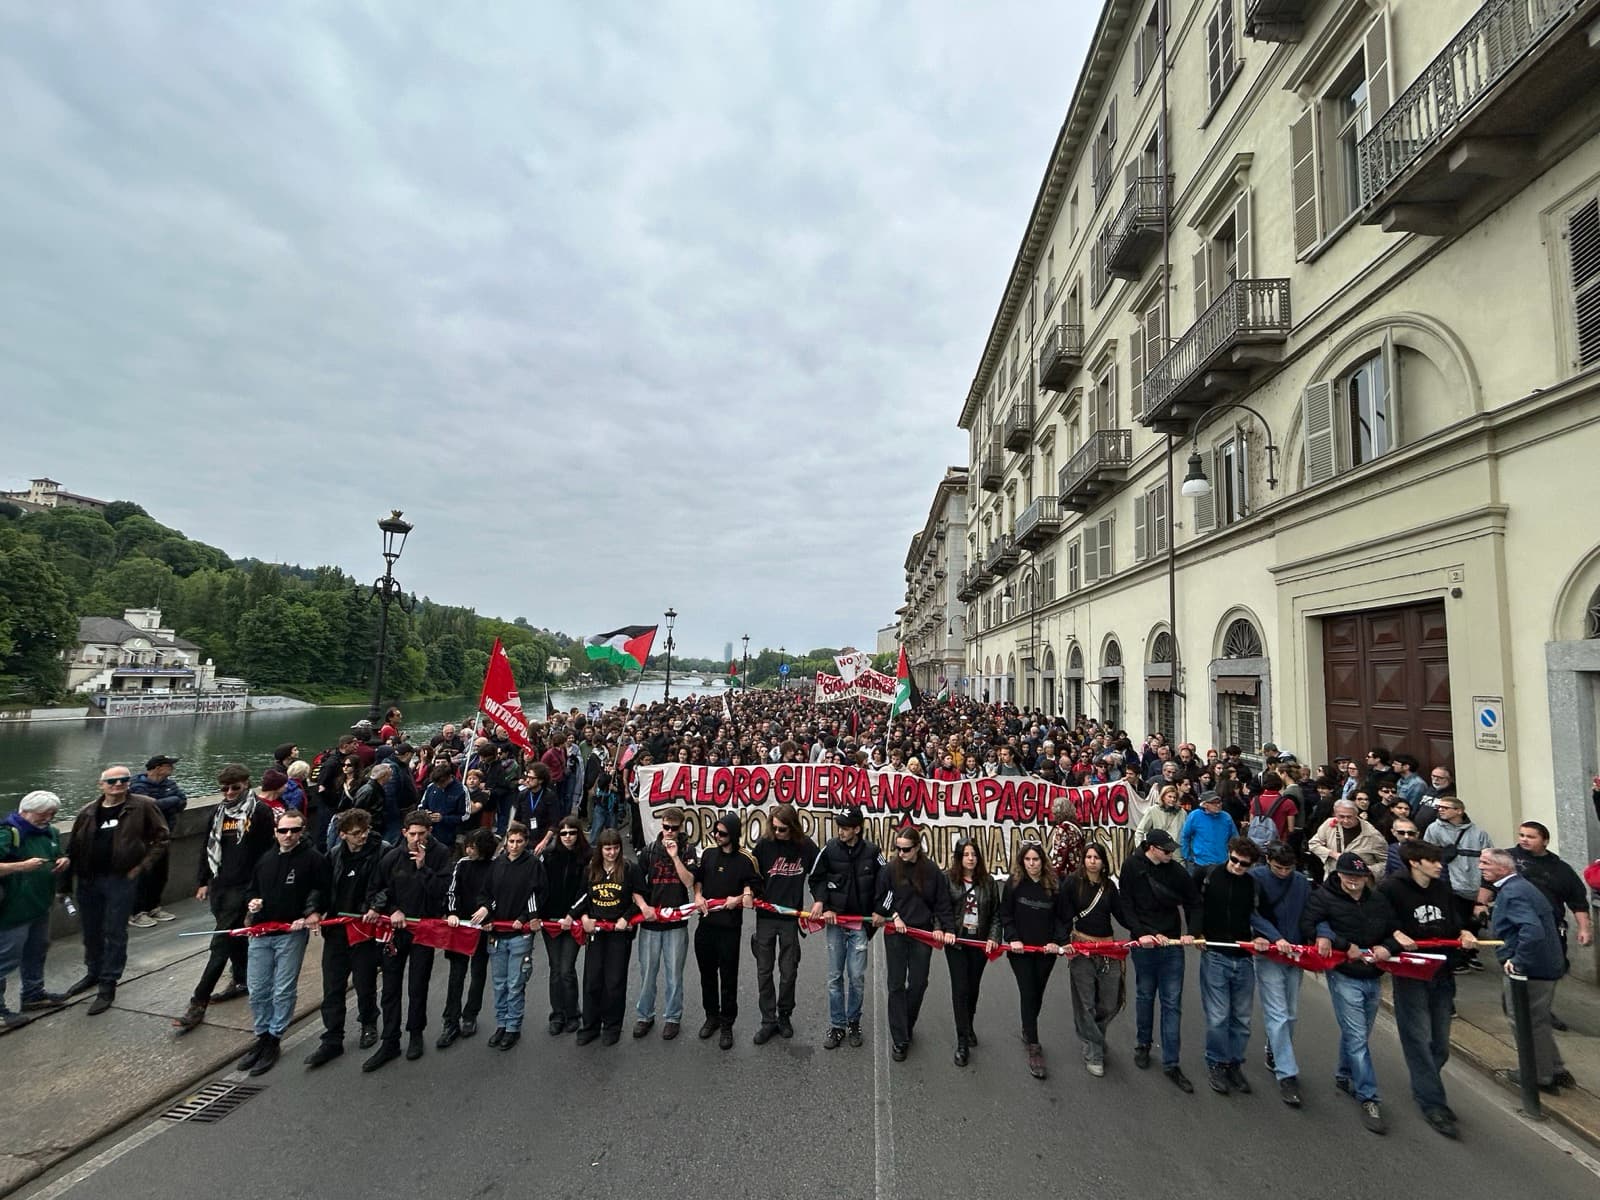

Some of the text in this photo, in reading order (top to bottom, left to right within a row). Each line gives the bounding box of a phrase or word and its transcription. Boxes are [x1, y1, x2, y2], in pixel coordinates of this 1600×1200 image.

[839, 657, 853, 667] NO
[818, 688, 857, 701] PALESTIN
[649, 765, 693, 807] LA
[695, 766, 771, 808] LORO
[773, 764, 880, 813] GUERRA
[875, 773, 939, 819] NON
[944, 781, 982, 819] LA
